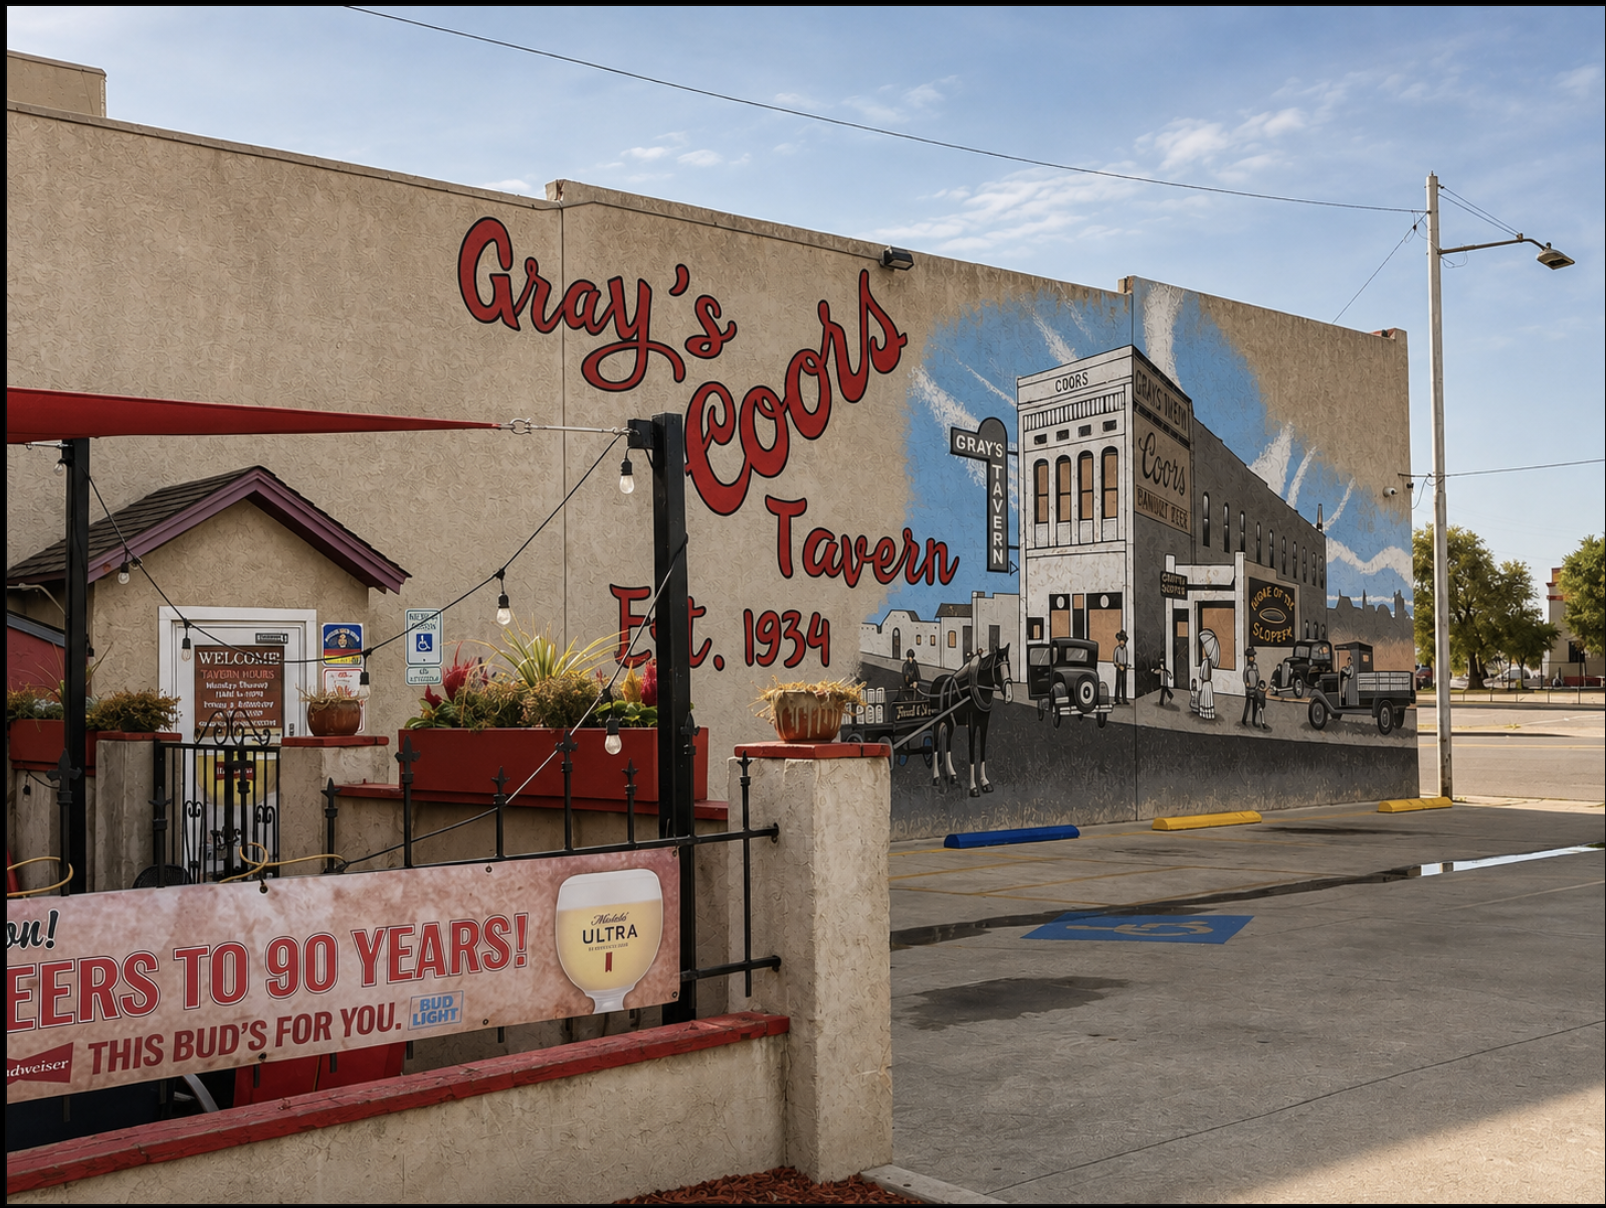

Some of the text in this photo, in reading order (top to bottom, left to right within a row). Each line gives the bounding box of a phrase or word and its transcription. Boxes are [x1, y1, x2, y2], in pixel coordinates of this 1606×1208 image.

[458, 217, 737, 391] Gray's
[684, 269, 907, 516] Coors
[1055, 371, 1088, 393] COORS
[956, 435, 1003, 457] GRAY'S
[1138, 432, 1186, 496] Coors
[765, 495, 959, 588] Tavern
[991, 464, 1003, 564] TAVERN
[198, 651, 280, 665] WELCOME
[609, 583, 830, 671] Et. 1934
[582, 924, 638, 944] ULTRA
[7, 912, 529, 1034] EERS TO 90 YEARS!
[419, 995, 454, 1012] BUD
[88, 1002, 402, 1075] THIS BUD'S FOR YOU.
[412, 1008, 458, 1026] LIGHT
